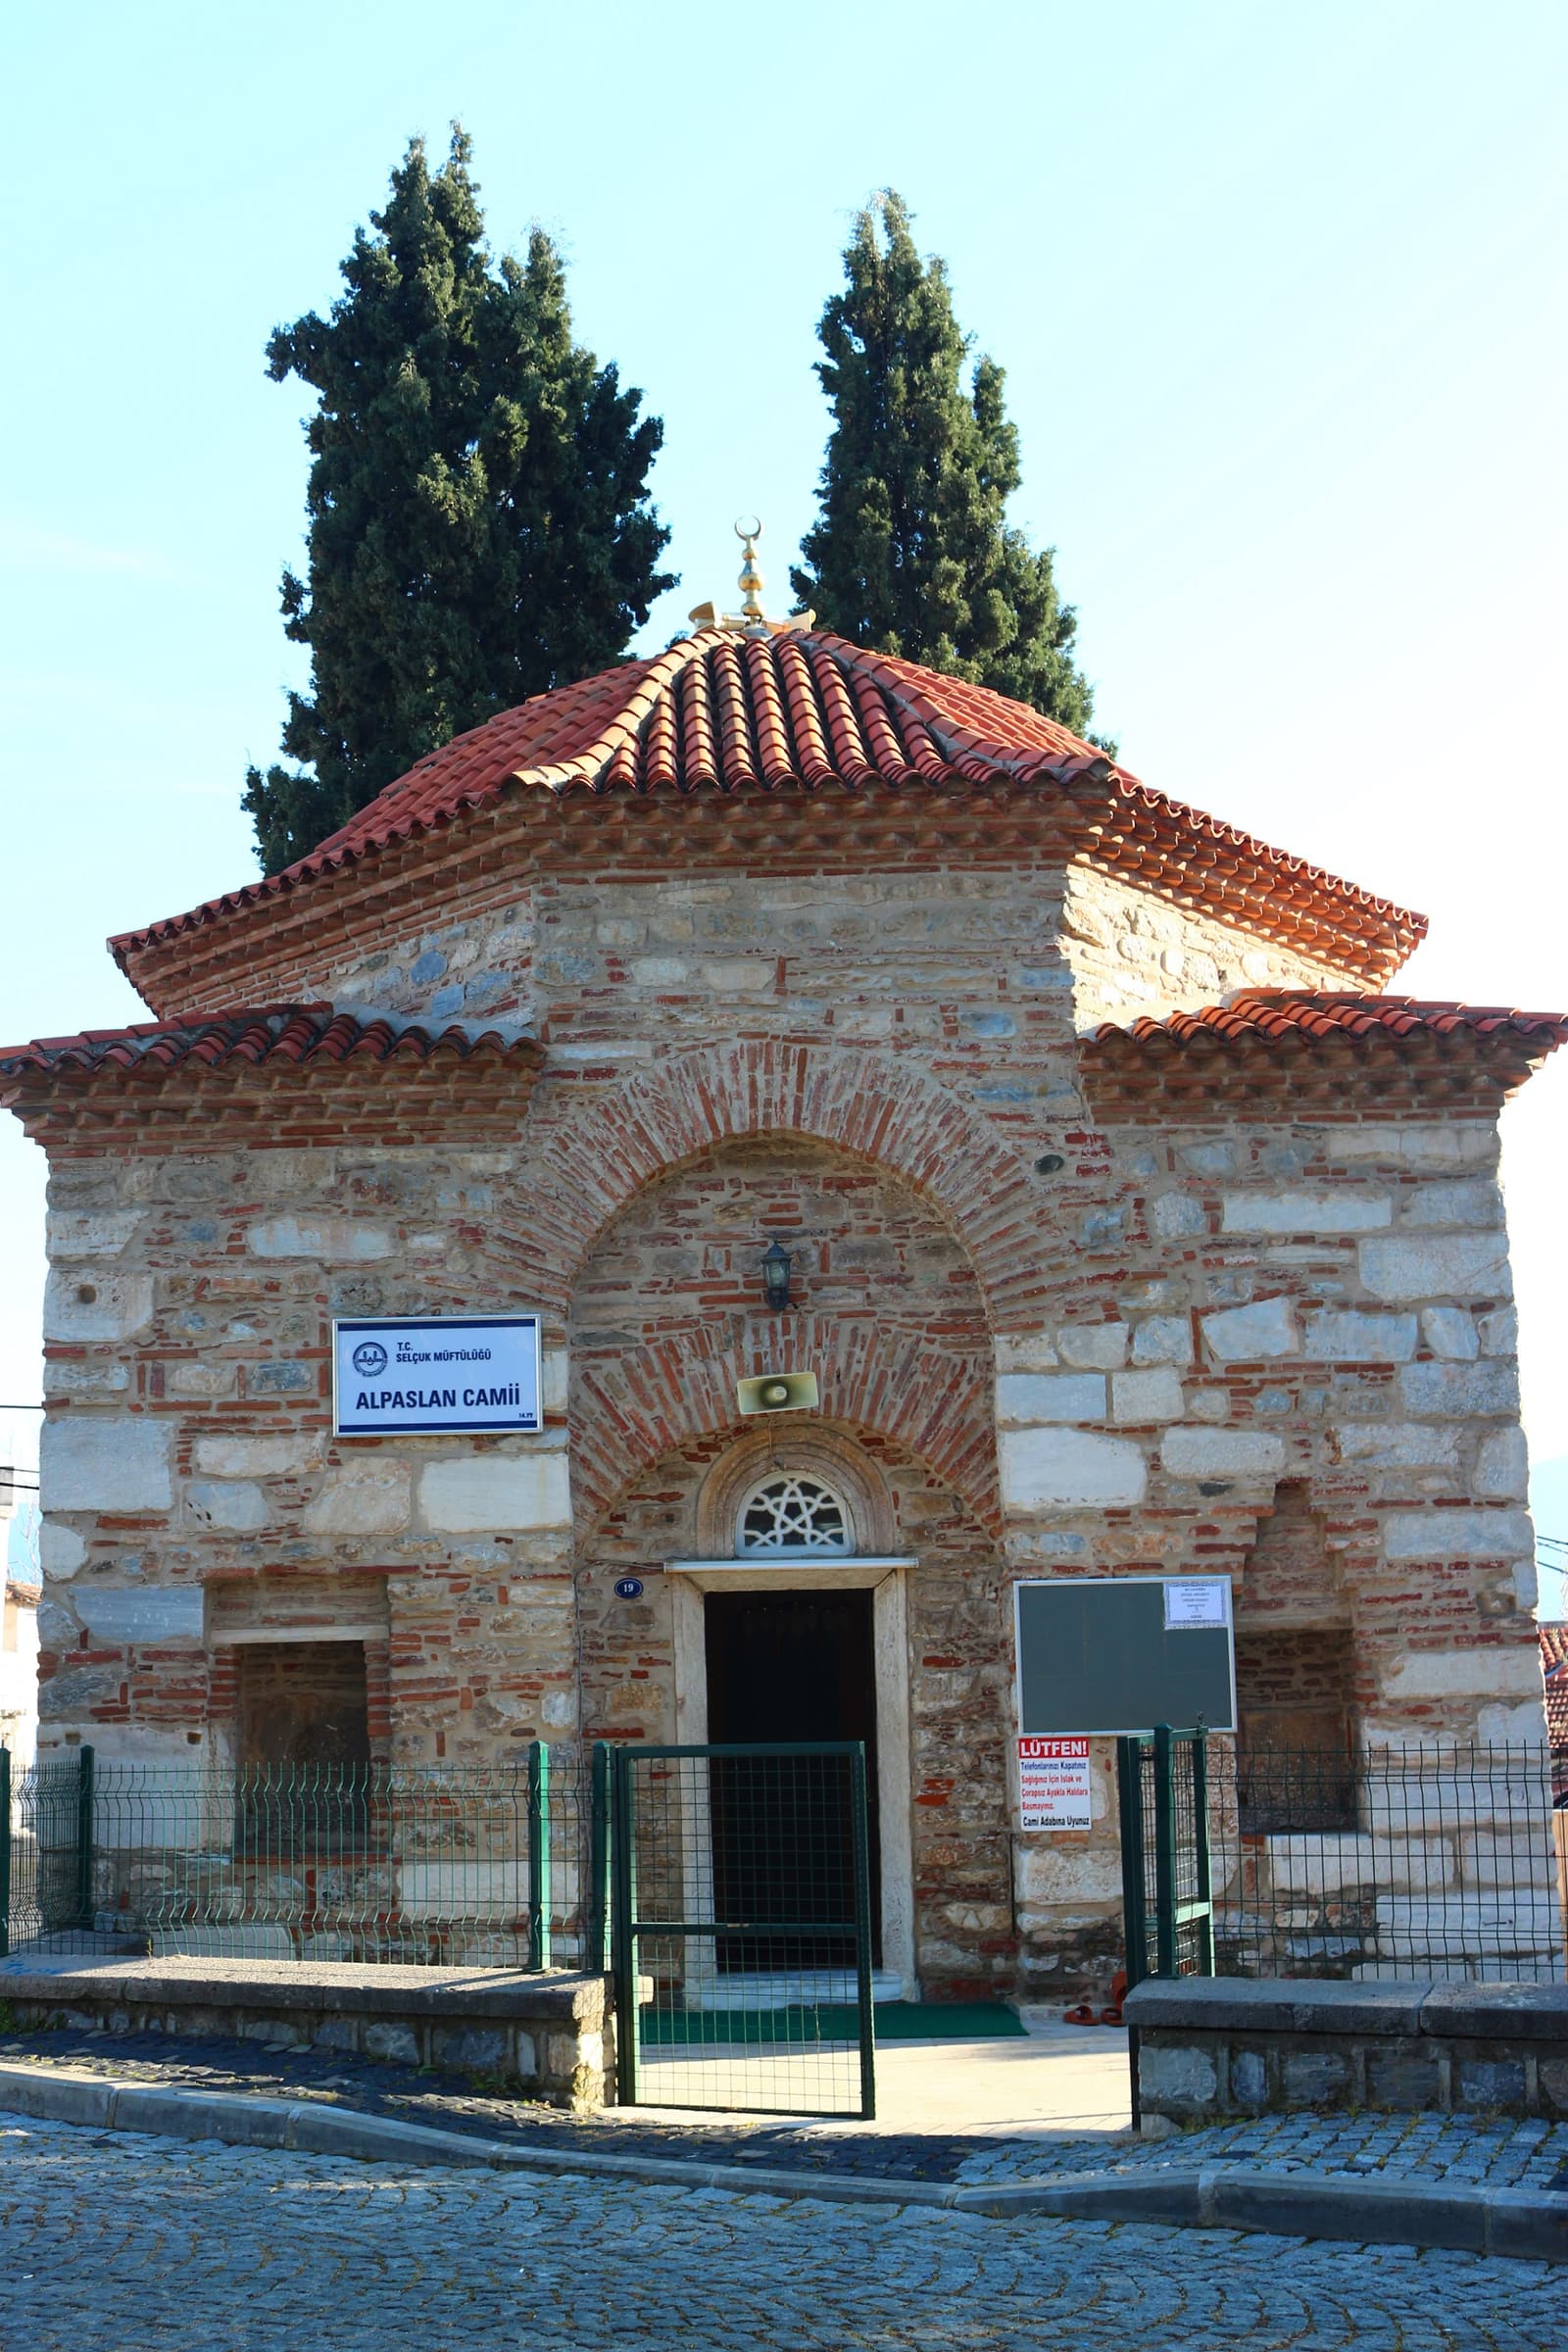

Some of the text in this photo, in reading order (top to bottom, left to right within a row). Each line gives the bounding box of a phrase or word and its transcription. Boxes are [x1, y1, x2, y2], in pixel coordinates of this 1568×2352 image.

[397, 1342, 413, 1351] T.C.
[396, 1348, 491, 1364] SELÇUK MÜFTÜLÜĞÜ
[356, 1390, 456, 1409] ALPASLAN
[623, 1583, 634, 1592] 19
[1020, 1740, 1087, 1757] LÜTFEN!
[1023, 1815, 1090, 1828] Cami Adabına Uyunuz
